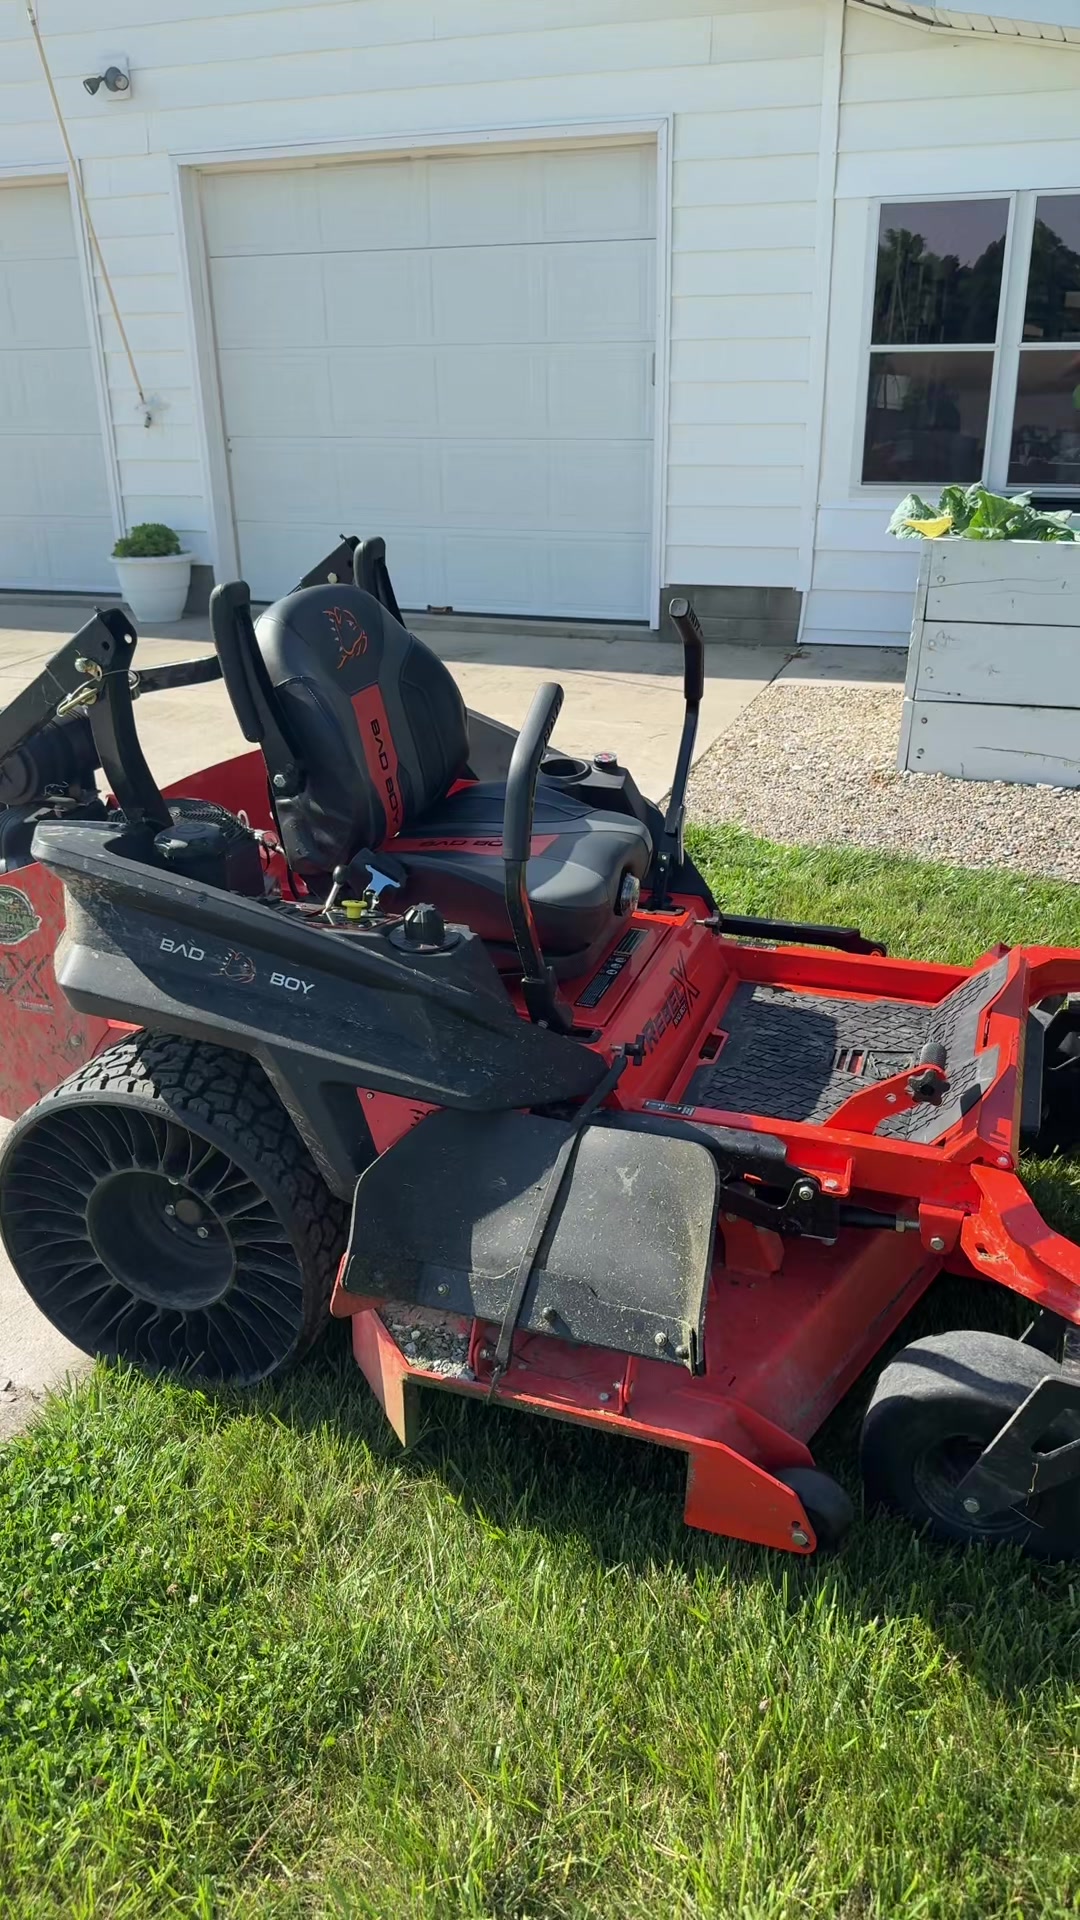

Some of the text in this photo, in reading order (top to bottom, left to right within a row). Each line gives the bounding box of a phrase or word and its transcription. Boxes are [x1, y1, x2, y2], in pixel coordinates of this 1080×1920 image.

[370, 718, 399, 824] BAD BOY
[420, 840, 503, 848] BAD BO
[159, 938, 315, 994] BAD BOY
